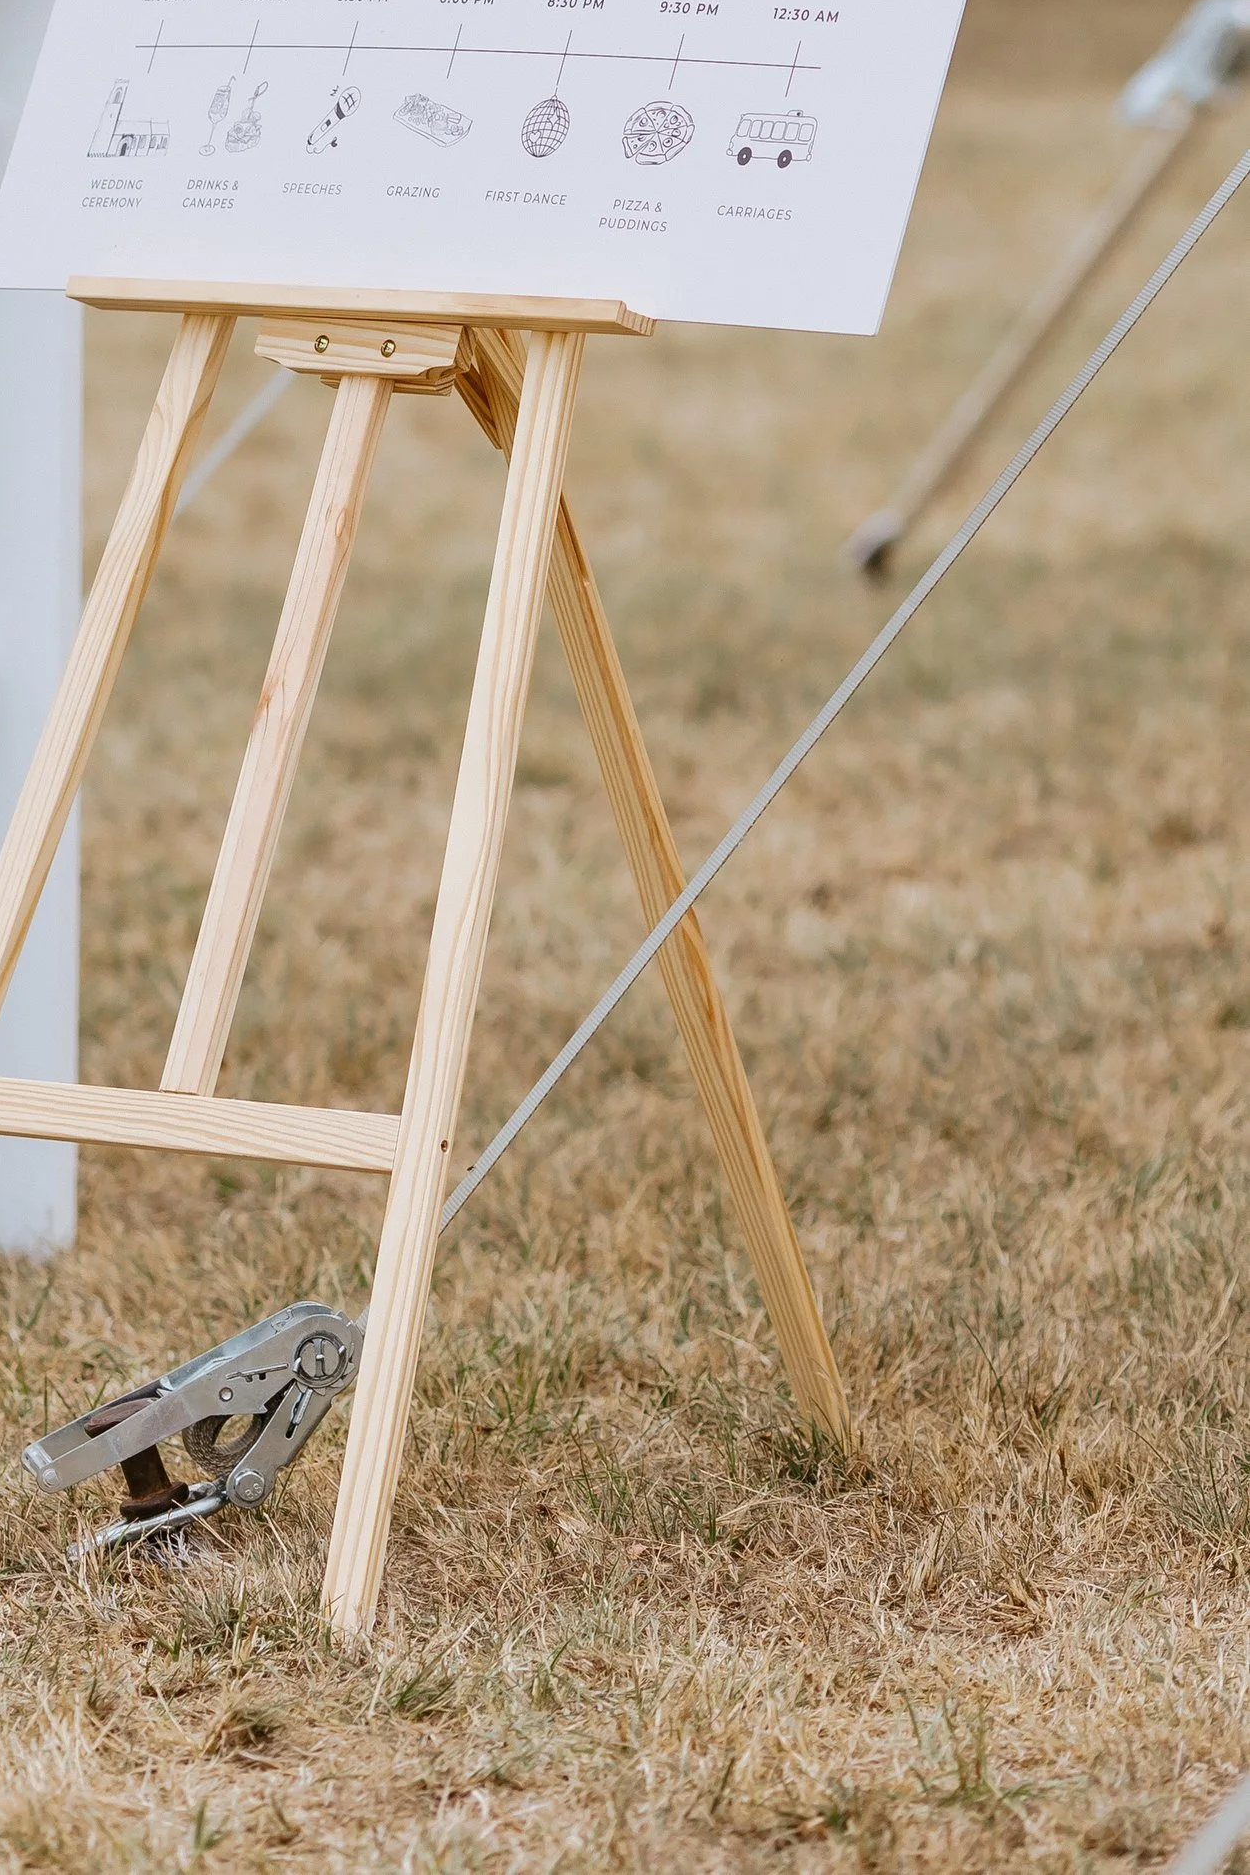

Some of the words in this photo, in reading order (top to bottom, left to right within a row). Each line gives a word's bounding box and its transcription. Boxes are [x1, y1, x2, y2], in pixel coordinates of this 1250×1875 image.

[659, 0, 691, 14] 9:30
[695, 3, 719, 16] PM
[773, 7, 810, 21] 12:30
[814, 10, 840, 23] AM
[89, 178, 144, 191] WEDDING
[186, 178, 230, 191] DRINKS
[231, 180, 239, 191] &
[281, 181, 343, 196] SPEECHES
[386, 185, 441, 199] GRAZING
[81, 196, 143, 208] CEREMONY
[182, 197, 235, 210] CANAPES
[484, 190, 521, 203] FIRST
[522, 192, 568, 206] DANCE
[612, 198, 650, 212] PIZZA
[654, 201, 663, 213] &
[716, 204, 794, 222] CARRIAGES
[597, 216, 669, 233] PUDDINGS
